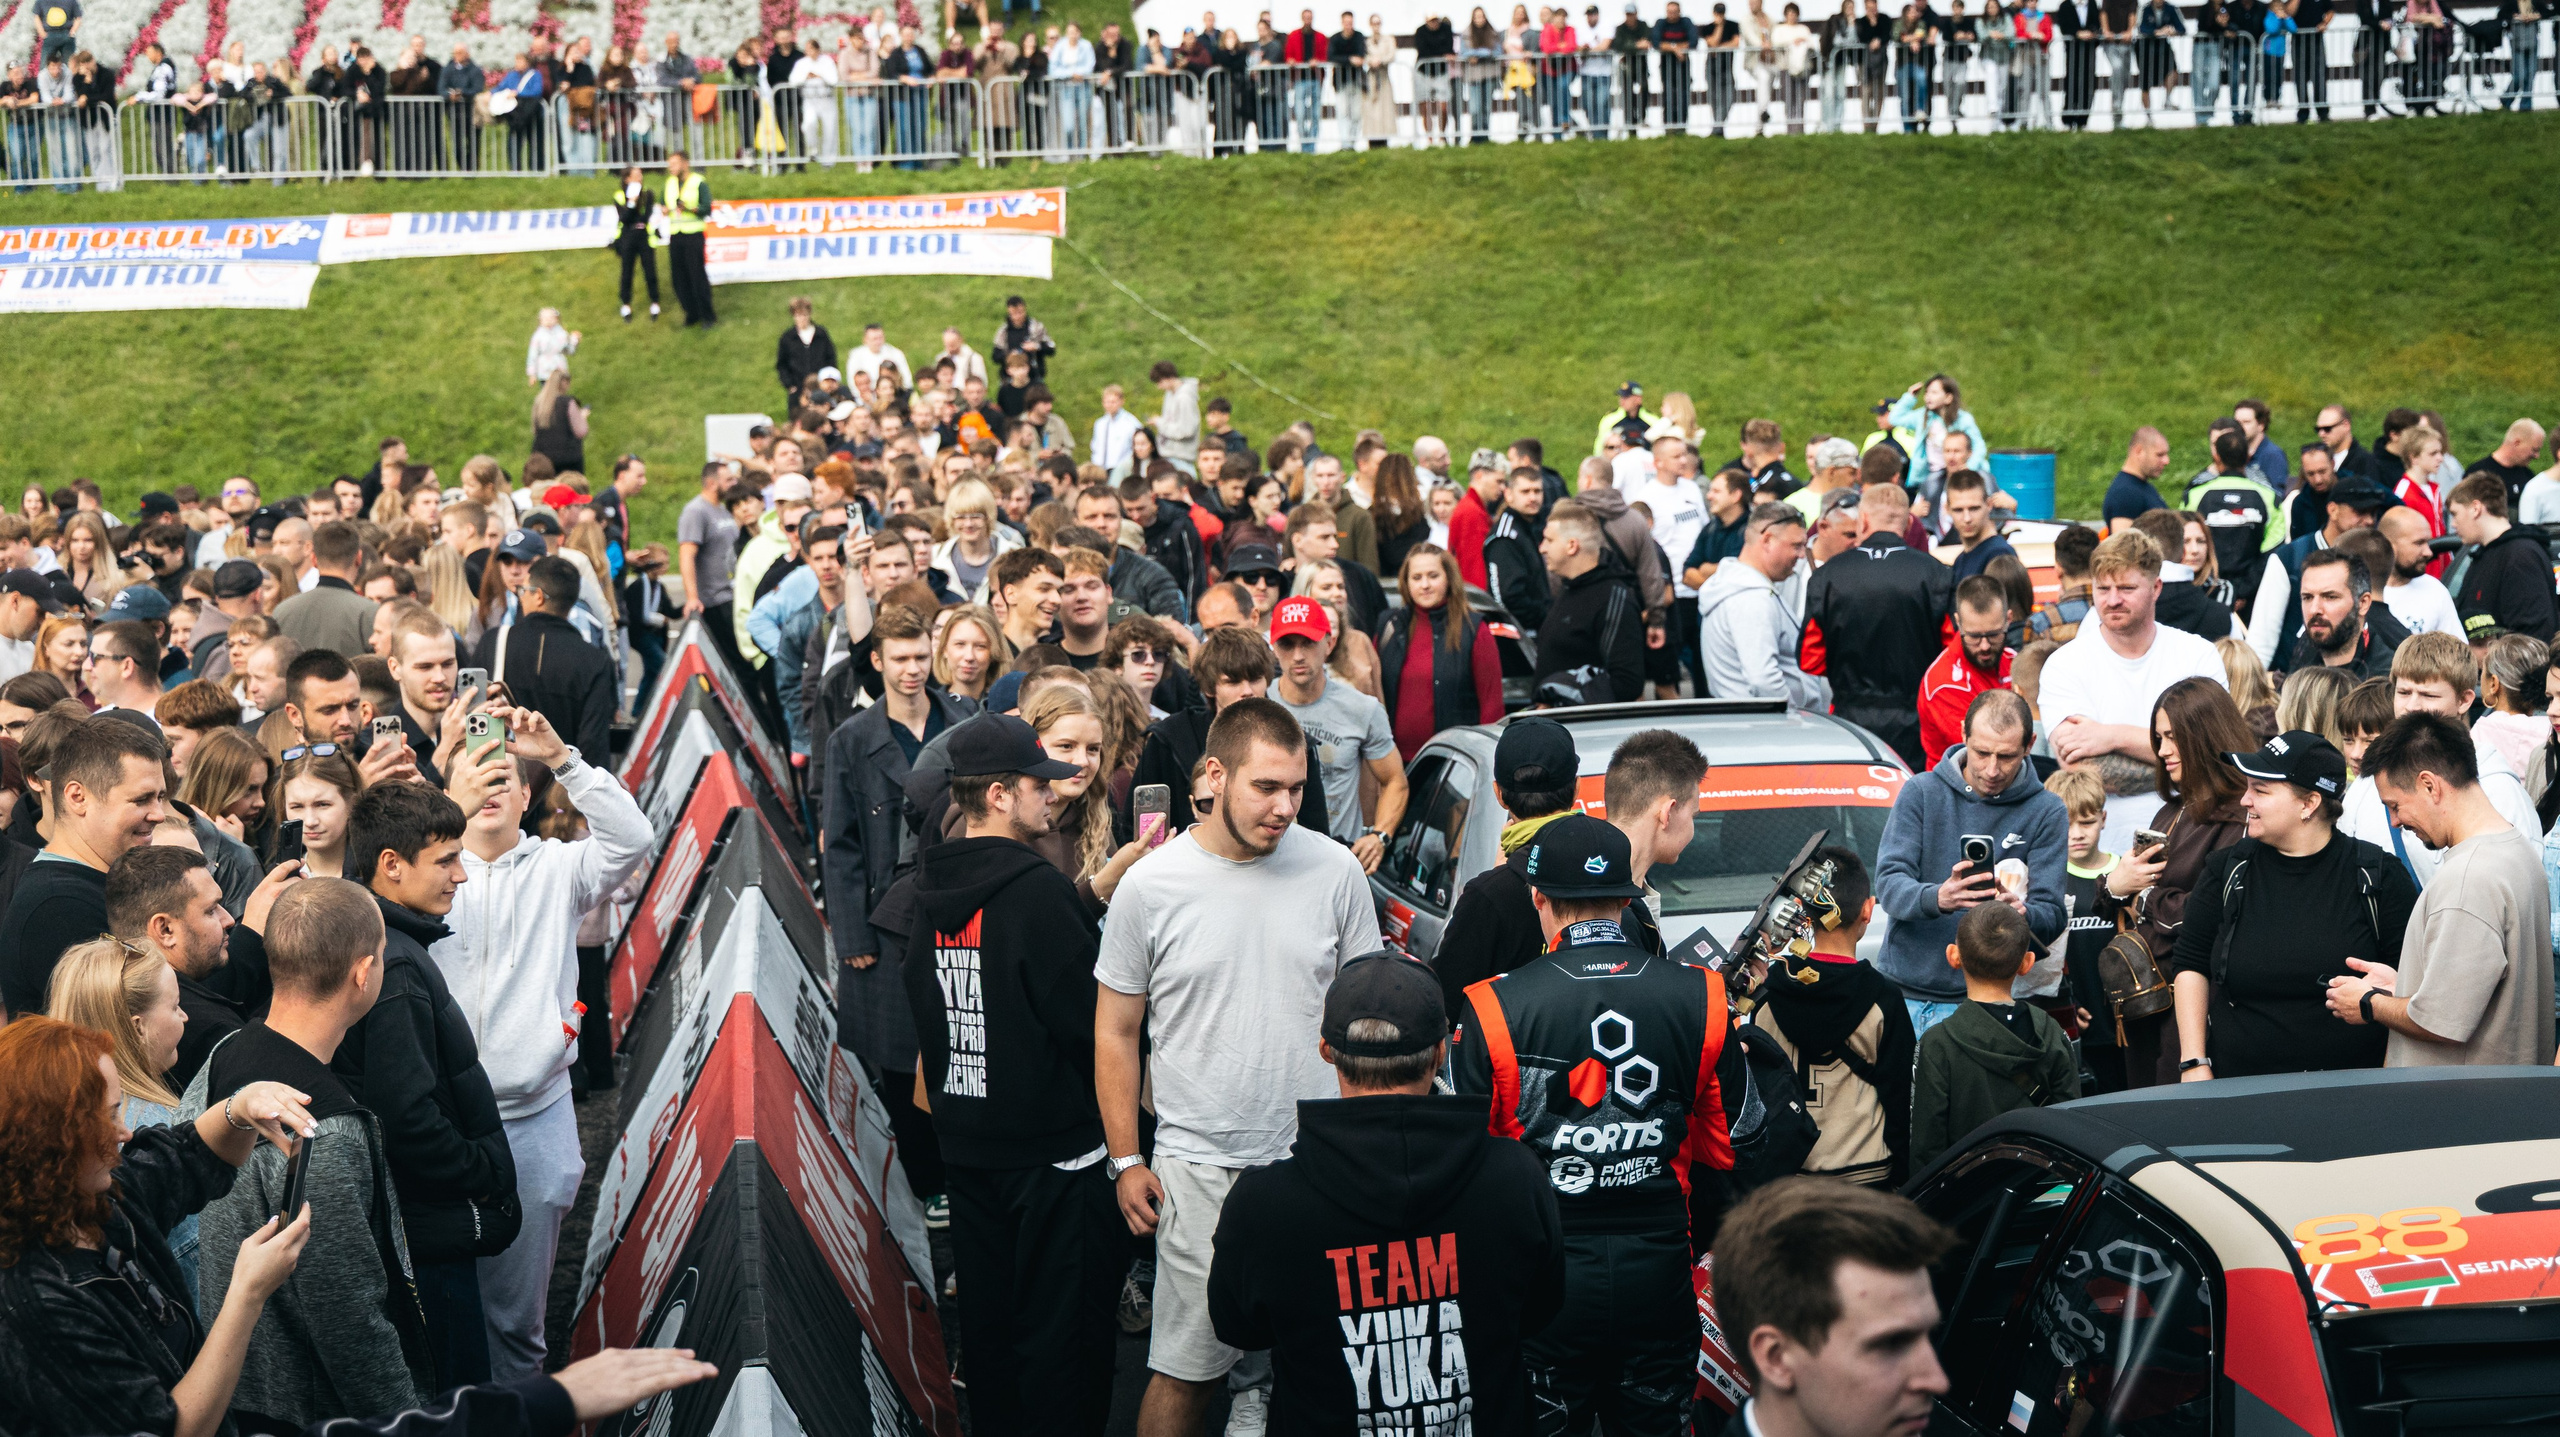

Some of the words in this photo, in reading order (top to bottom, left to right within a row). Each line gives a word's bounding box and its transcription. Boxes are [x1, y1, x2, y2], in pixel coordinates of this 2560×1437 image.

[410, 206, 612, 234] DINITROL
[767, 233, 972, 261] DINITROL
[20, 264, 228, 289] DINITROL
[1281, 610, 1309, 624] CITY
[943, 1063, 987, 1098] ACING
[1551, 1117, 1664, 1154] FORTIS
[1600, 1165, 1662, 1188] WHEELS
[1601, 1156, 1658, 1176] POWER
[2294, 1206, 2469, 1265] 88
[1325, 1232, 1460, 1311] TEAM
[1342, 1331, 1471, 1409] YUKA
